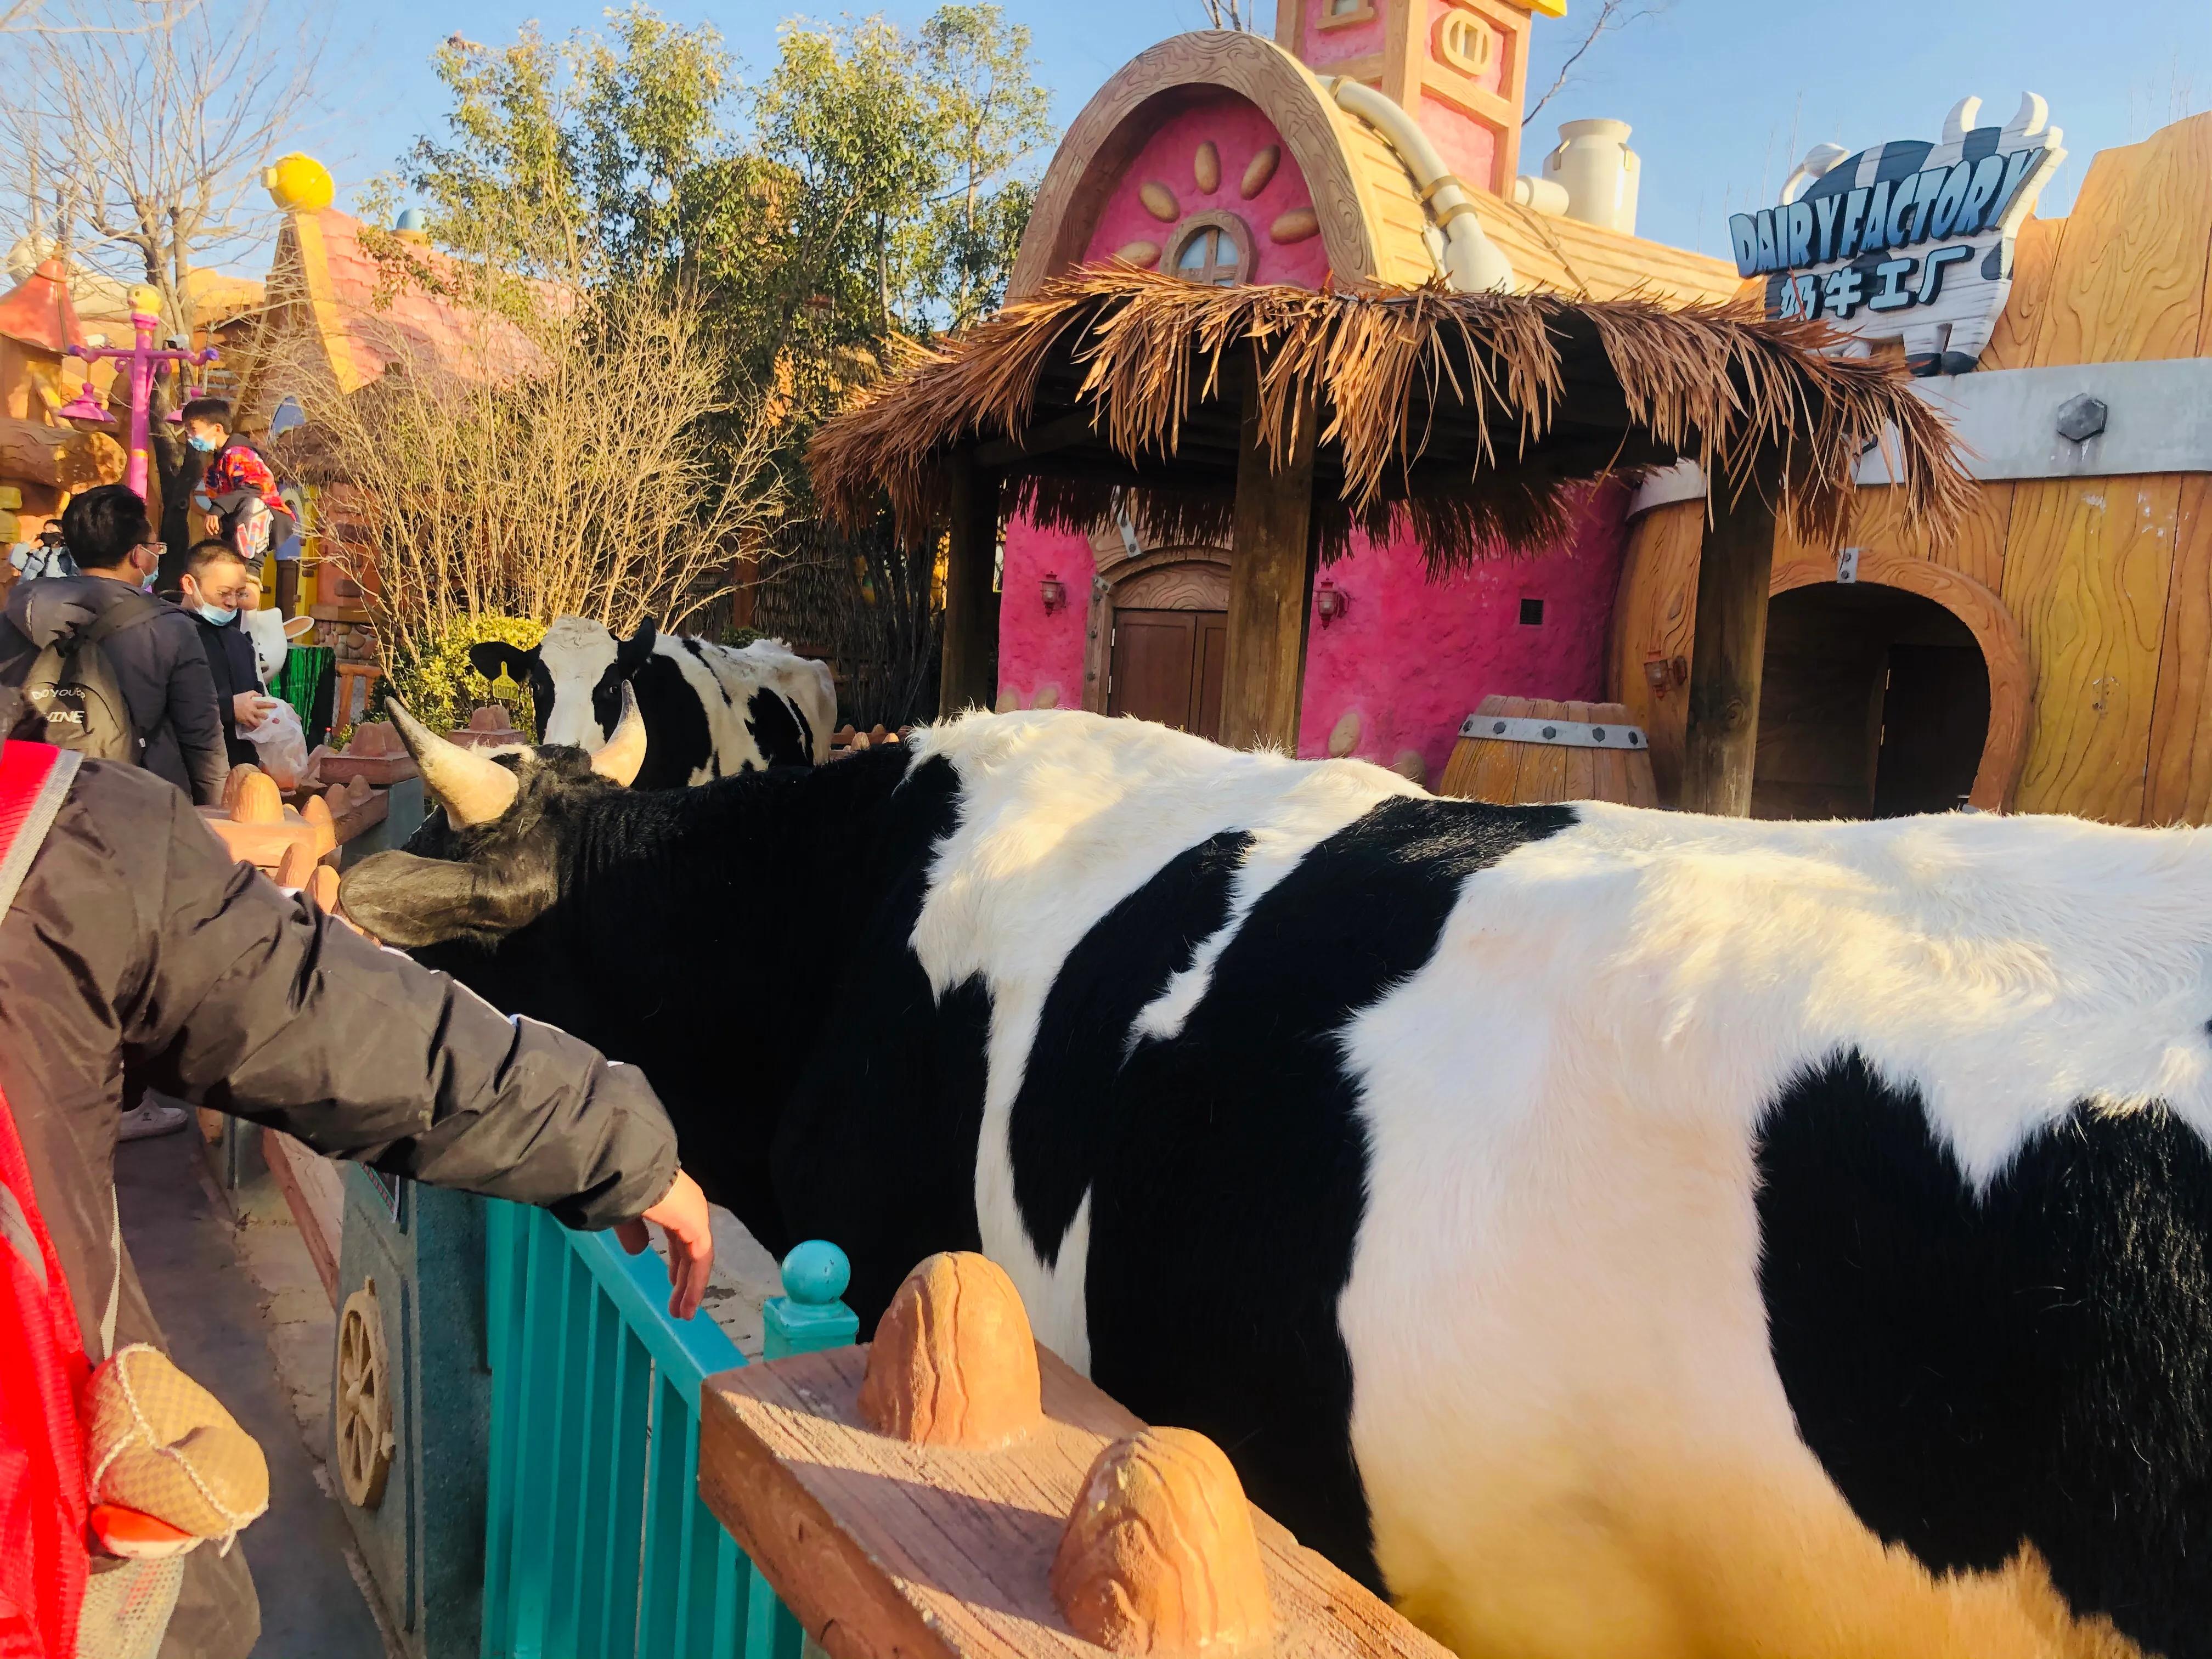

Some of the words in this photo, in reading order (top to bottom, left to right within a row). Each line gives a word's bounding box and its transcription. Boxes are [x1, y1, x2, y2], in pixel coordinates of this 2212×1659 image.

[1729, 193, 1843, 279] DAIRY
[1839, 147, 2048, 256] FACTORY
[1779, 245, 1972, 321] 奶牛工厂
